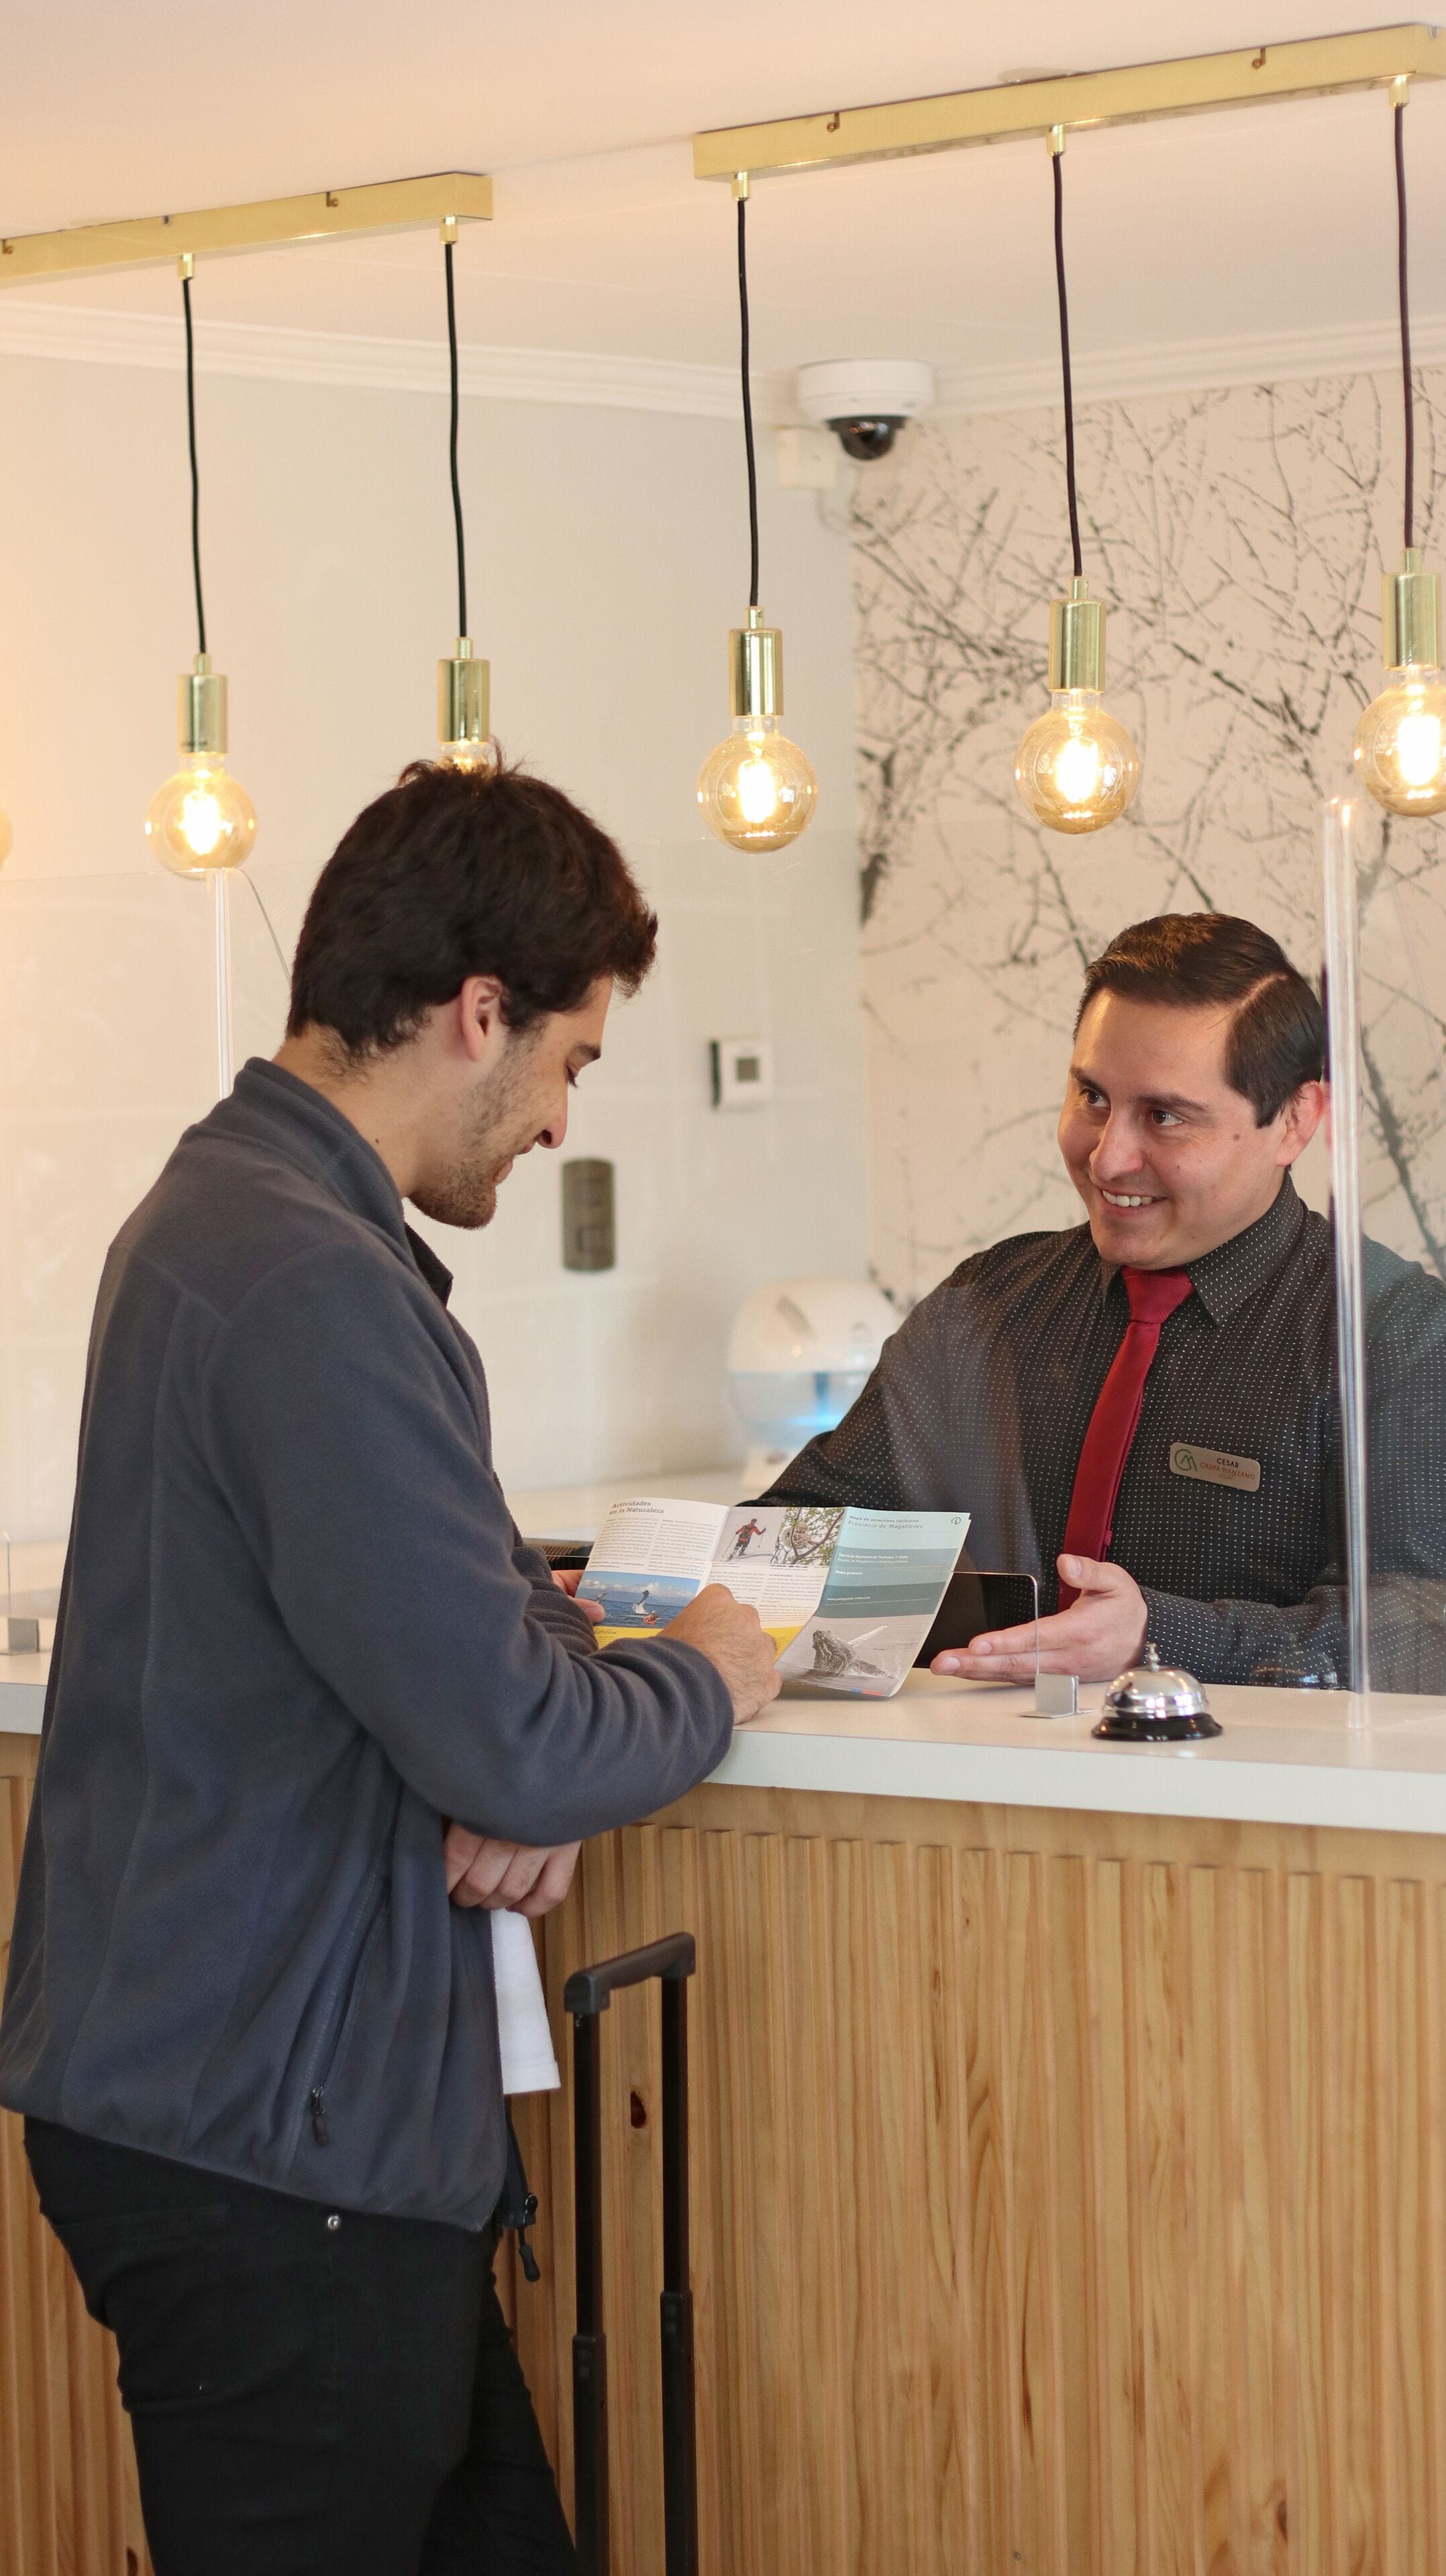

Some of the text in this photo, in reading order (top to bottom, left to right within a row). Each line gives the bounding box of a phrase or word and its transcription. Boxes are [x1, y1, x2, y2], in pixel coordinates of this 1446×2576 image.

[1217, 1458, 1239, 1468] CESAR
[1222, 1467, 1255, 1481] MANZANO
[611, 1501, 652, 1509] Actividades
[847, 1520, 877, 1529] Provincia
